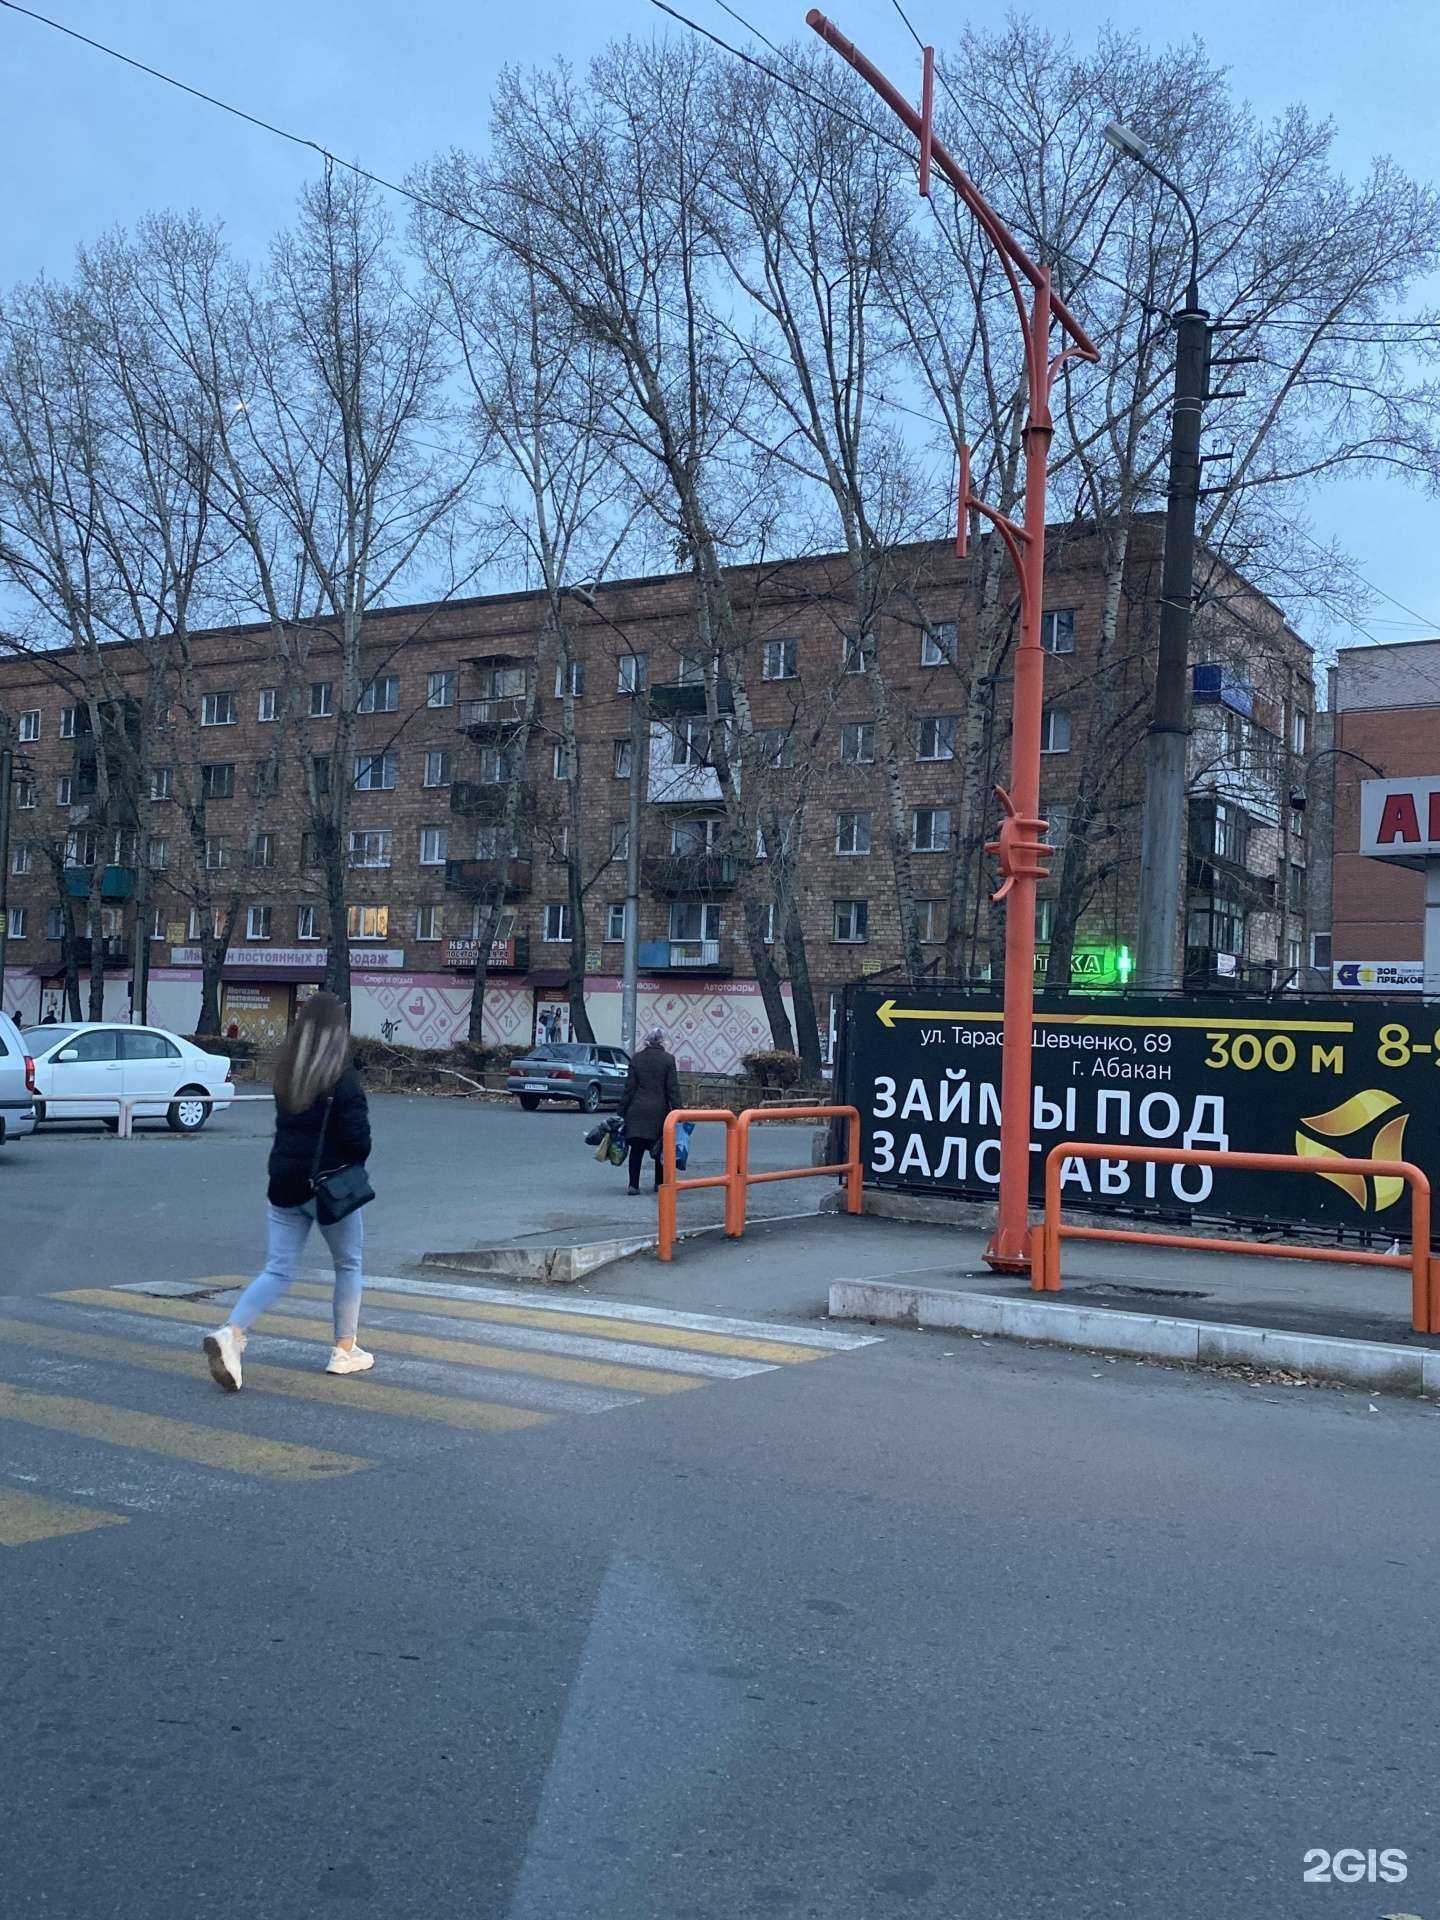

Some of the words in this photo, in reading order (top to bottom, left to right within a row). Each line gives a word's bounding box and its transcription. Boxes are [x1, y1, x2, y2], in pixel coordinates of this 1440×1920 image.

[1376, 792, 1440, 844] А
[238, 951, 311, 963] постоянных
[449, 940, 508, 949] КВАРРЫ
[1376, 967, 1398, 976] ЗОВ
[703, 982, 756, 993] Автотовары
[920, 1028, 946, 1046] ул.
[951, 1026, 1005, 1048] Тарас
[1031, 1029, 1137, 1054] Шевченко,
[1143, 1033, 1172, 1053] 69
[1204, 1032, 1297, 1072] 300
[1376, 1023, 1440, 1068] 8-
[1072, 1060, 1084, 1076] г.
[1091, 1056, 1172, 1080] Абакан
[1096, 1088, 1229, 1152] ПОД
[871, 1130, 1042, 1184] ЗАЛО
